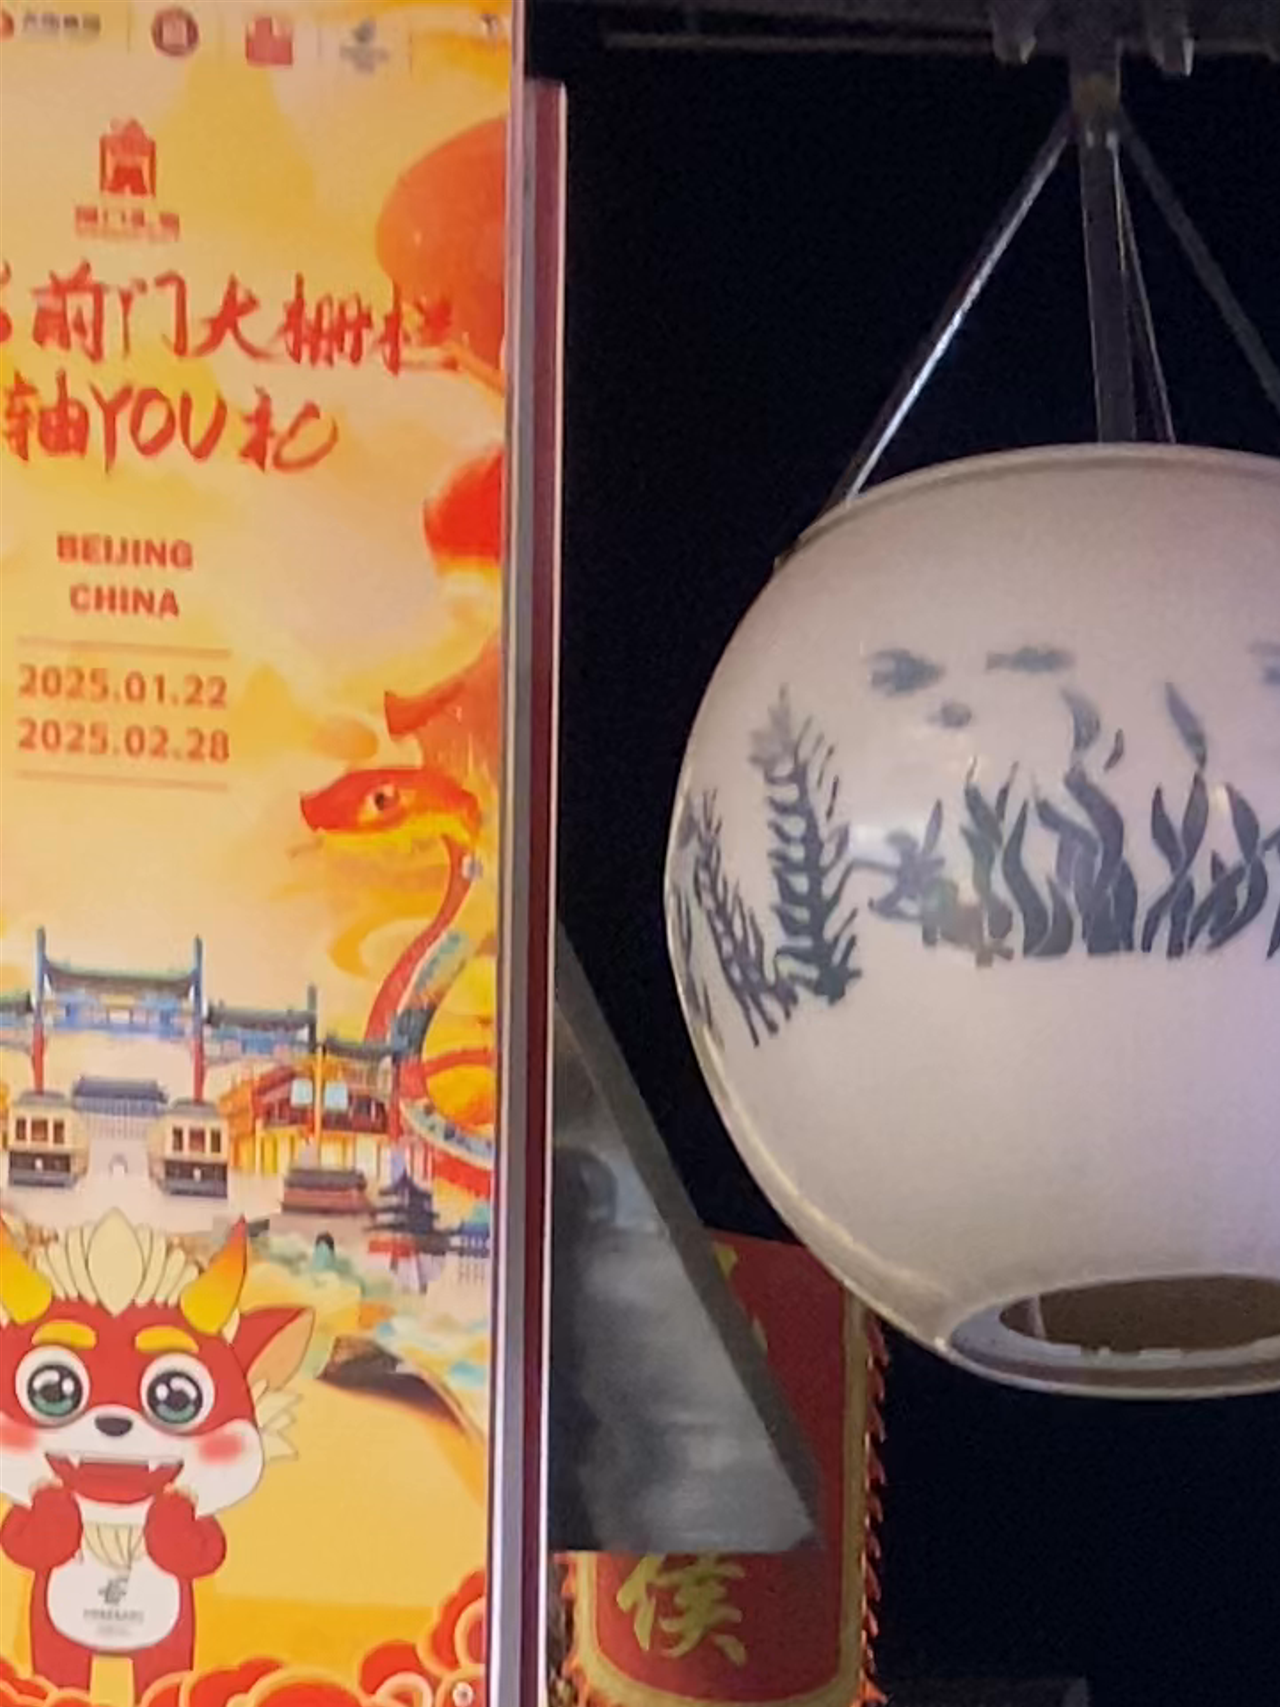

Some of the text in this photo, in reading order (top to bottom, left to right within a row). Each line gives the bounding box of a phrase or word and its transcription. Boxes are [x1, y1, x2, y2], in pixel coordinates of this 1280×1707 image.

[56, 531, 193, 572] BEIJING
[69, 582, 180, 619] CHINA
[18, 662, 228, 709] 2025.01.22
[18, 716, 230, 764] 2025.02.28
